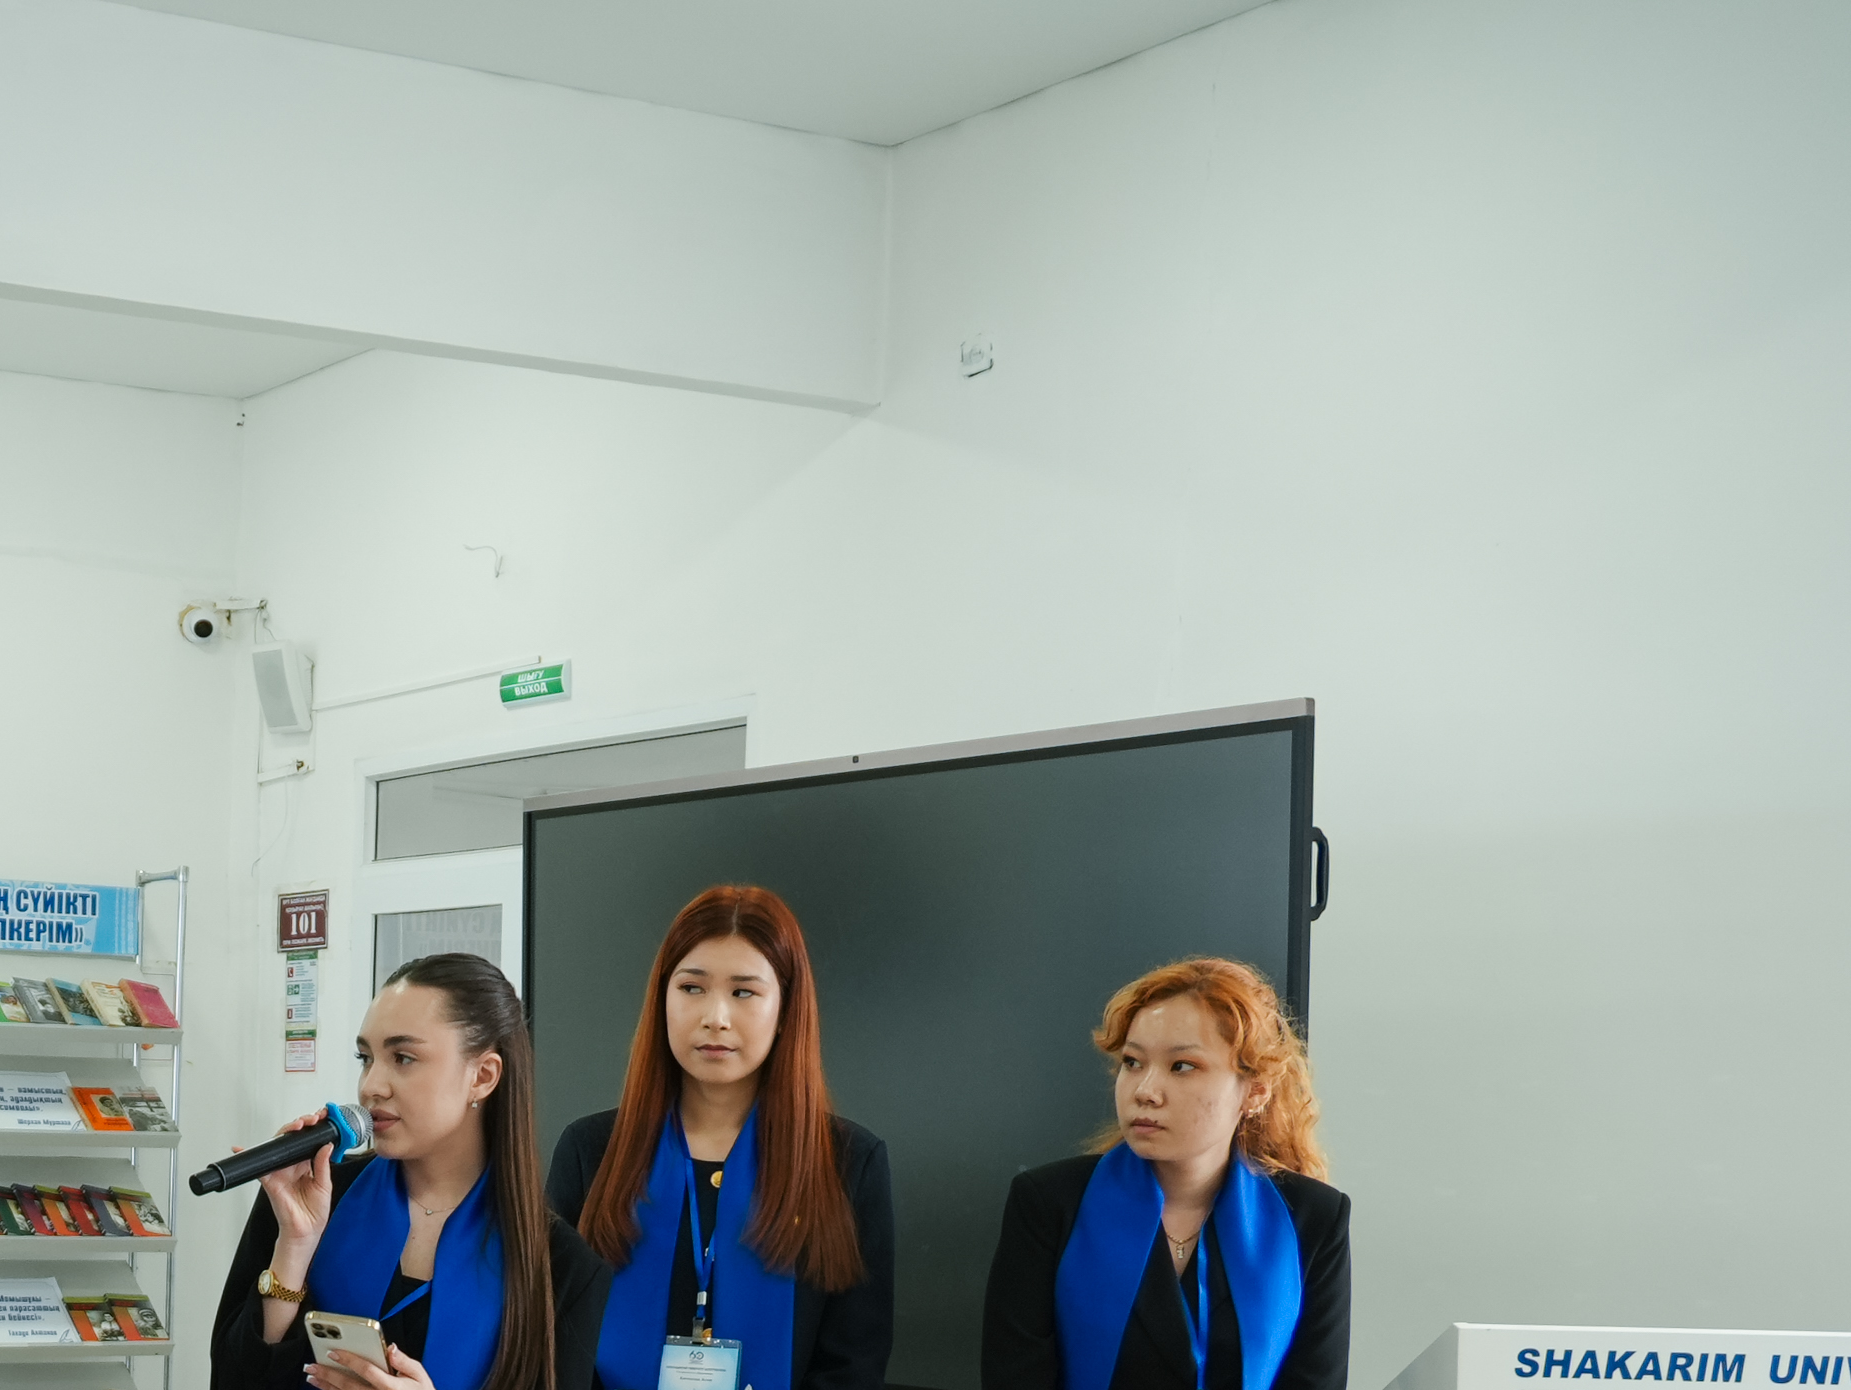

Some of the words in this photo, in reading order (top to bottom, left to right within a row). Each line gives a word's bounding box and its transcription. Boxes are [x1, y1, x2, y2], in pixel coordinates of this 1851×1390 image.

[514, 682, 548, 696] ВЫХОД
[15, 885, 97, 916] СҮЙІКТІ
[291, 911, 316, 936] 101
[1514, 1348, 1746, 1383] SHAKARIM
[1769, 1354, 1851, 1385] UNI
